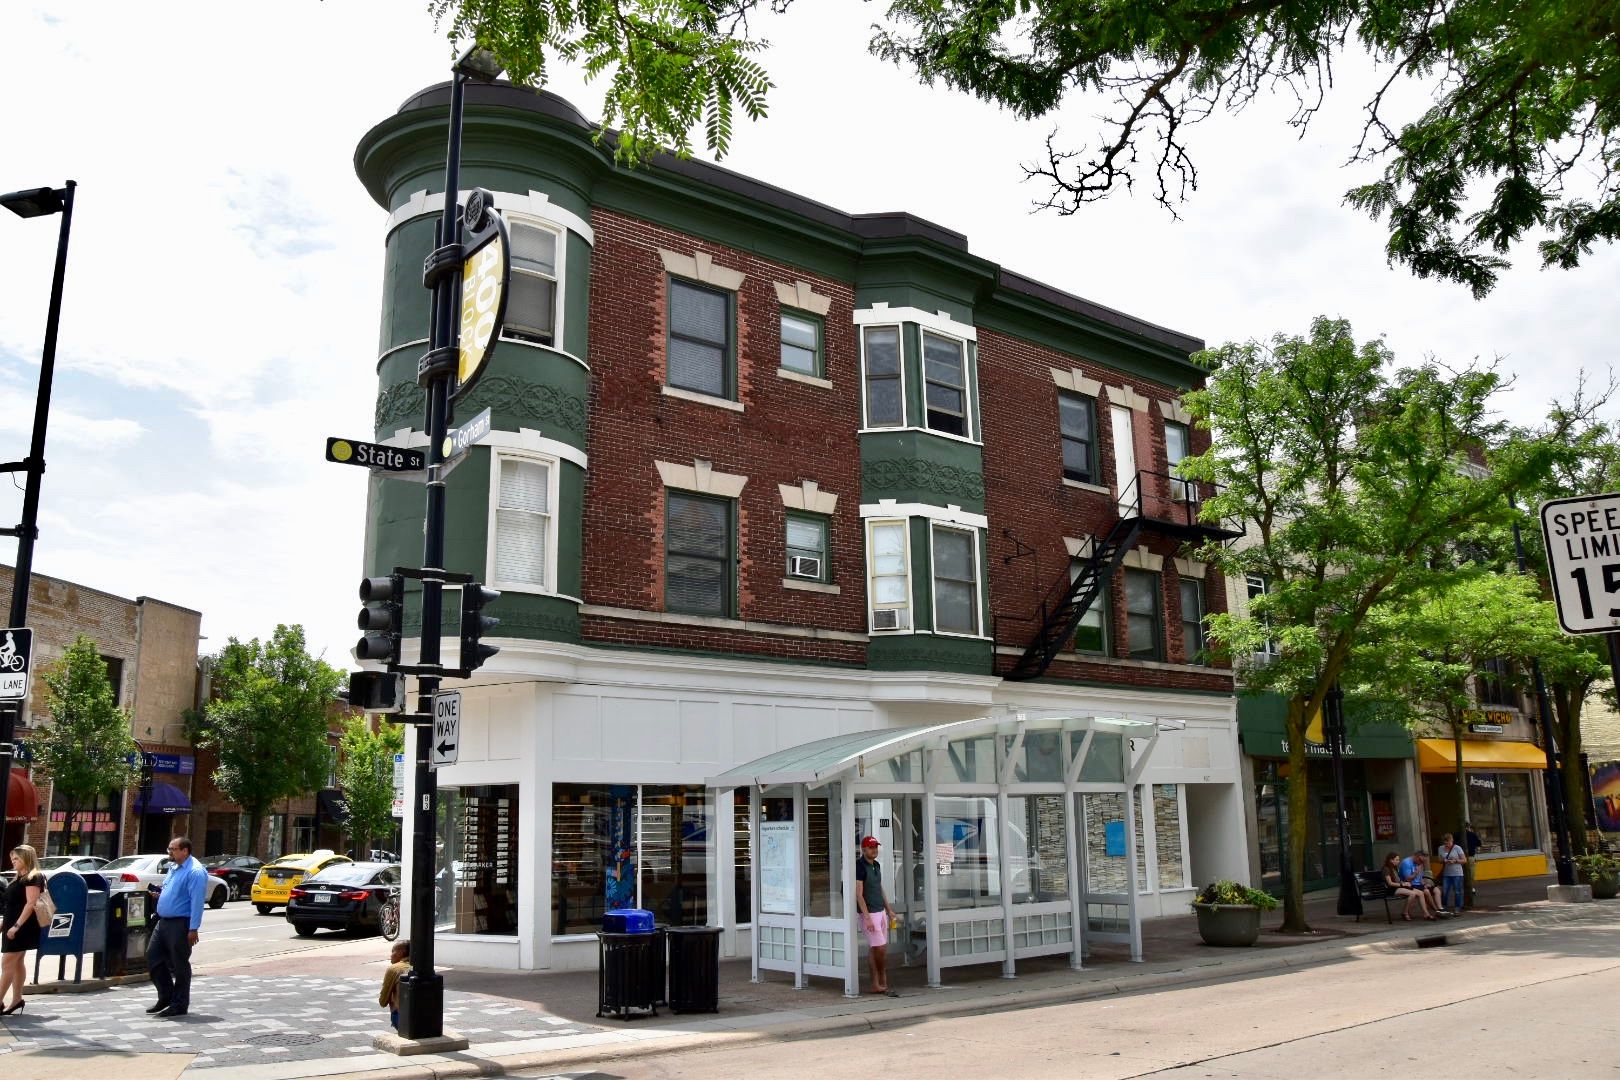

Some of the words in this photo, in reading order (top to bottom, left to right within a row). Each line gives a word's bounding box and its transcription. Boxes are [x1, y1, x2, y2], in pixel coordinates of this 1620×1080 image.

[474, 246, 498, 349] 400
[460, 273, 475, 362] BLOCK
[458, 419, 484, 448] Gorham
[357, 444, 404, 467] State
[410, 456, 420, 467] St
[1554, 508, 1620, 536] SPEE
[1566, 534, 1620, 560] LIMI
[3, 679, 23, 690] LANE
[438, 700, 457, 718] ONE
[436, 720, 456, 737] WAY
